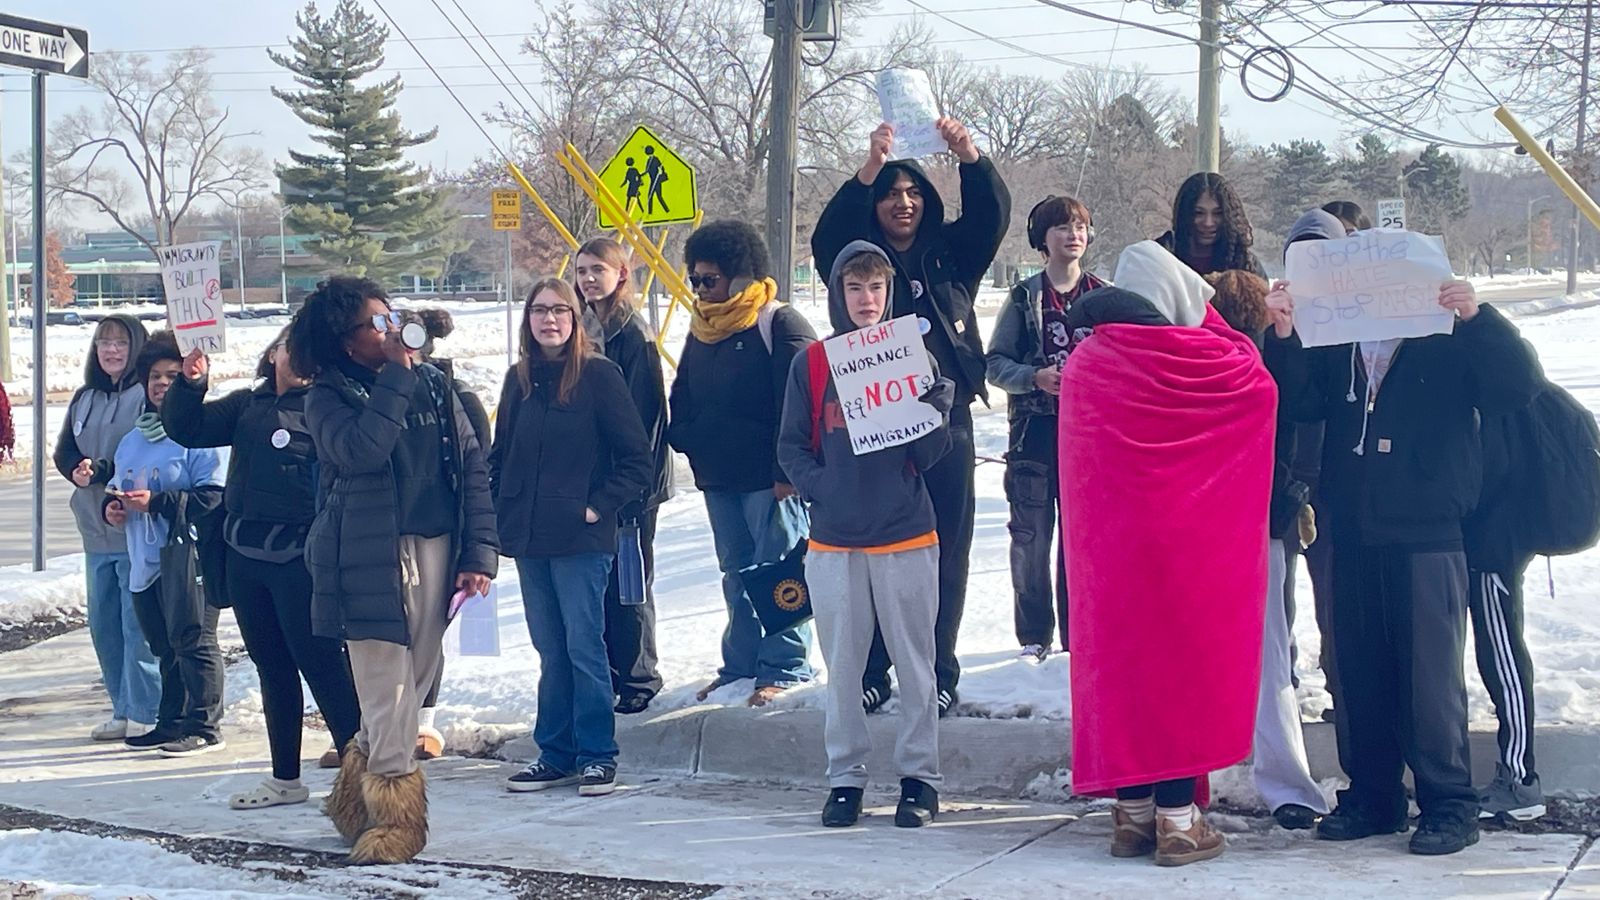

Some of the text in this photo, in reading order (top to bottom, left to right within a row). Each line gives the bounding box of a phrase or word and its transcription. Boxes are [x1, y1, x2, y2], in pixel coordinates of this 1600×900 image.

[2, 29, 67, 59] ONE WAY
[1382, 217, 1403, 229] 25
[159, 245, 216, 268] IMMIGRANTS
[1362, 238, 1410, 262] the
[169, 268, 208, 290] BUILT
[1329, 264, 1390, 291] HATE
[171, 297, 215, 321] THIS
[847, 321, 896, 351] FIGHT
[831, 345, 913, 379] IGNORANCE
[865, 374, 919, 411] NOT
[853, 419, 935, 451] IMMIGRANTS
